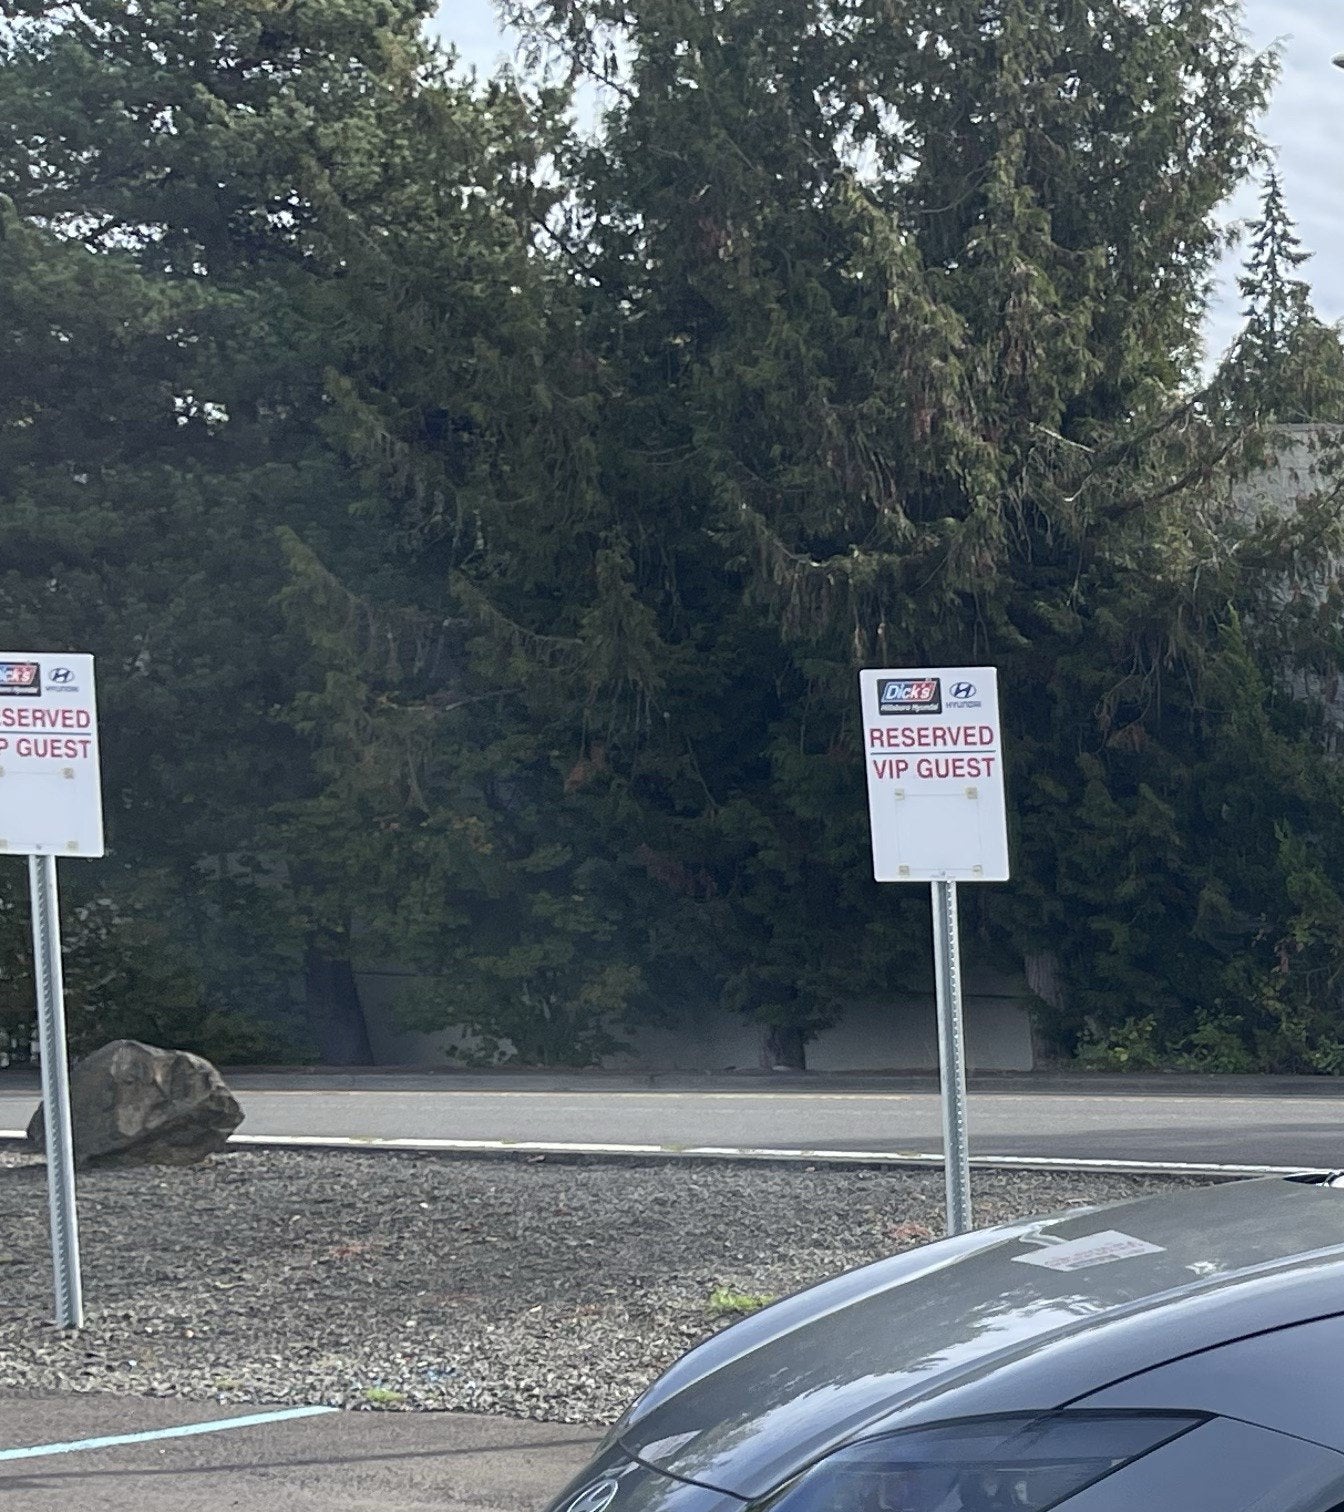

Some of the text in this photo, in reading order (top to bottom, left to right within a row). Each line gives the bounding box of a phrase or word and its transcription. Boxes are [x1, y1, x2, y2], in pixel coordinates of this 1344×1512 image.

[0, 708, 91, 728] SERVED
[869, 725, 995, 748] RESERVED
[16, 738, 91, 758] GUEST
[872, 757, 996, 780] VIP GUEST
